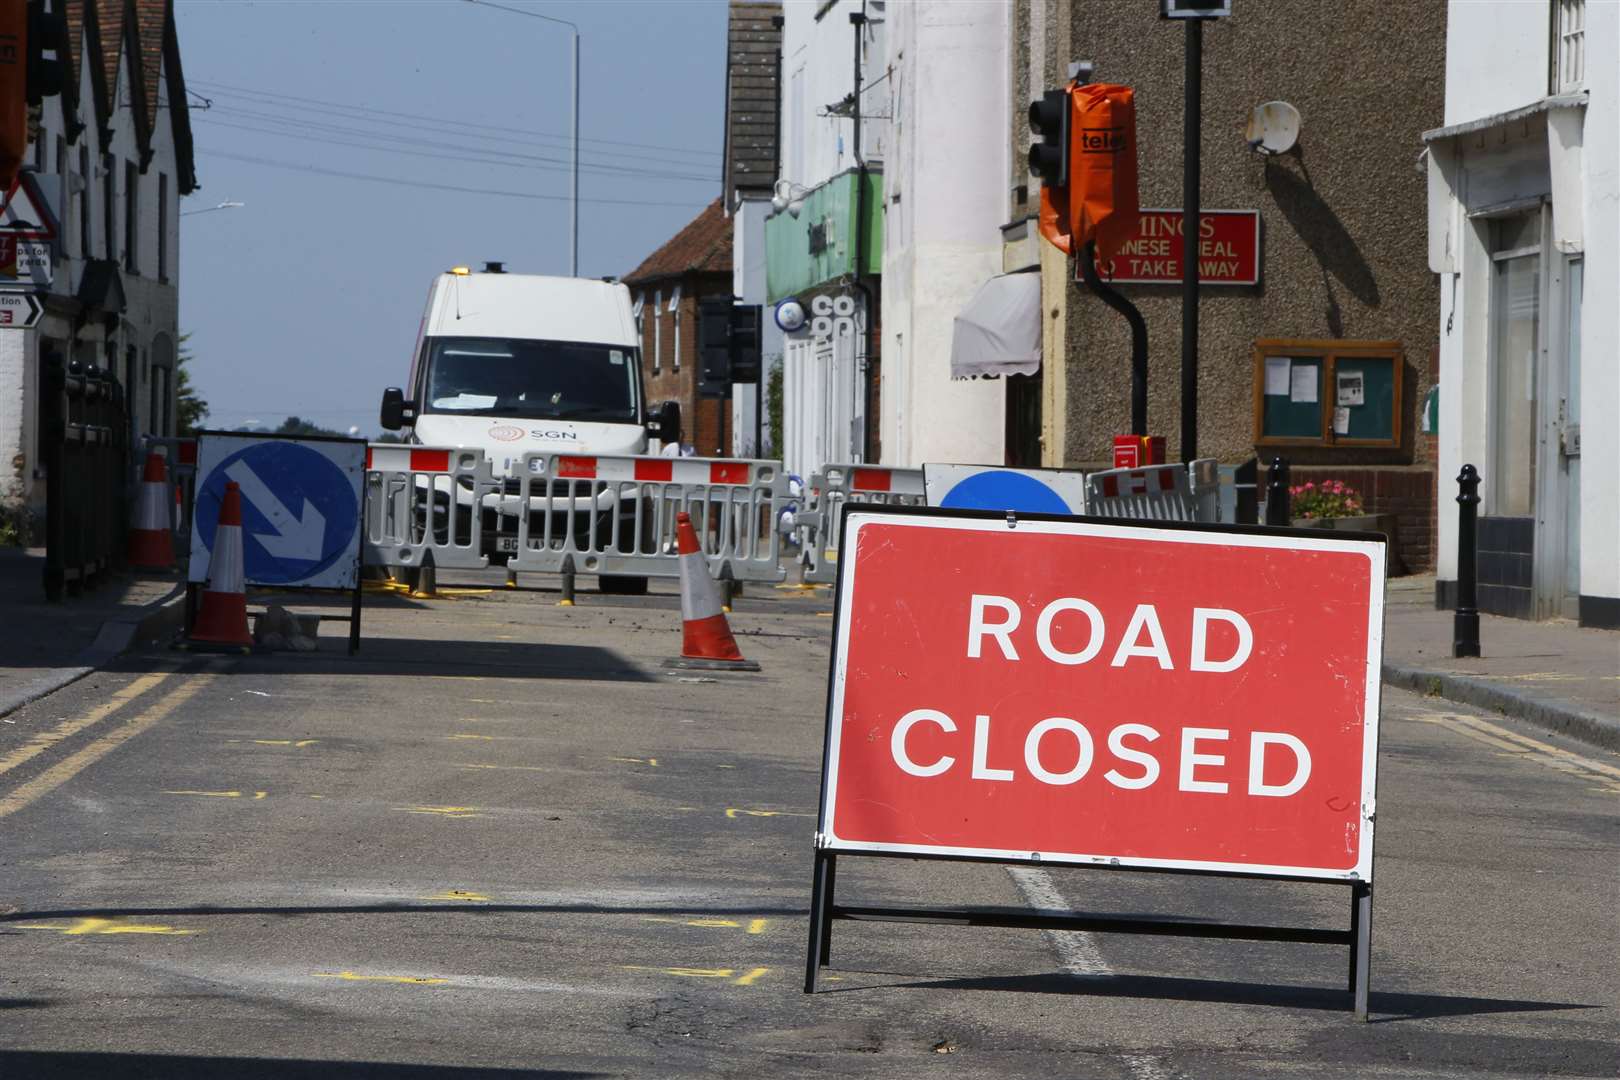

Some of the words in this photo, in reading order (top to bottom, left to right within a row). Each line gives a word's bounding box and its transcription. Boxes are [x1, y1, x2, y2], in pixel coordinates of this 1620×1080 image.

[1198, 240, 1239, 257] EAL
[1129, 259, 1177, 276] TAKE
[531, 429, 577, 440] SGN
[967, 594, 1253, 673] ROAD
[890, 708, 1312, 797] CLOSED
